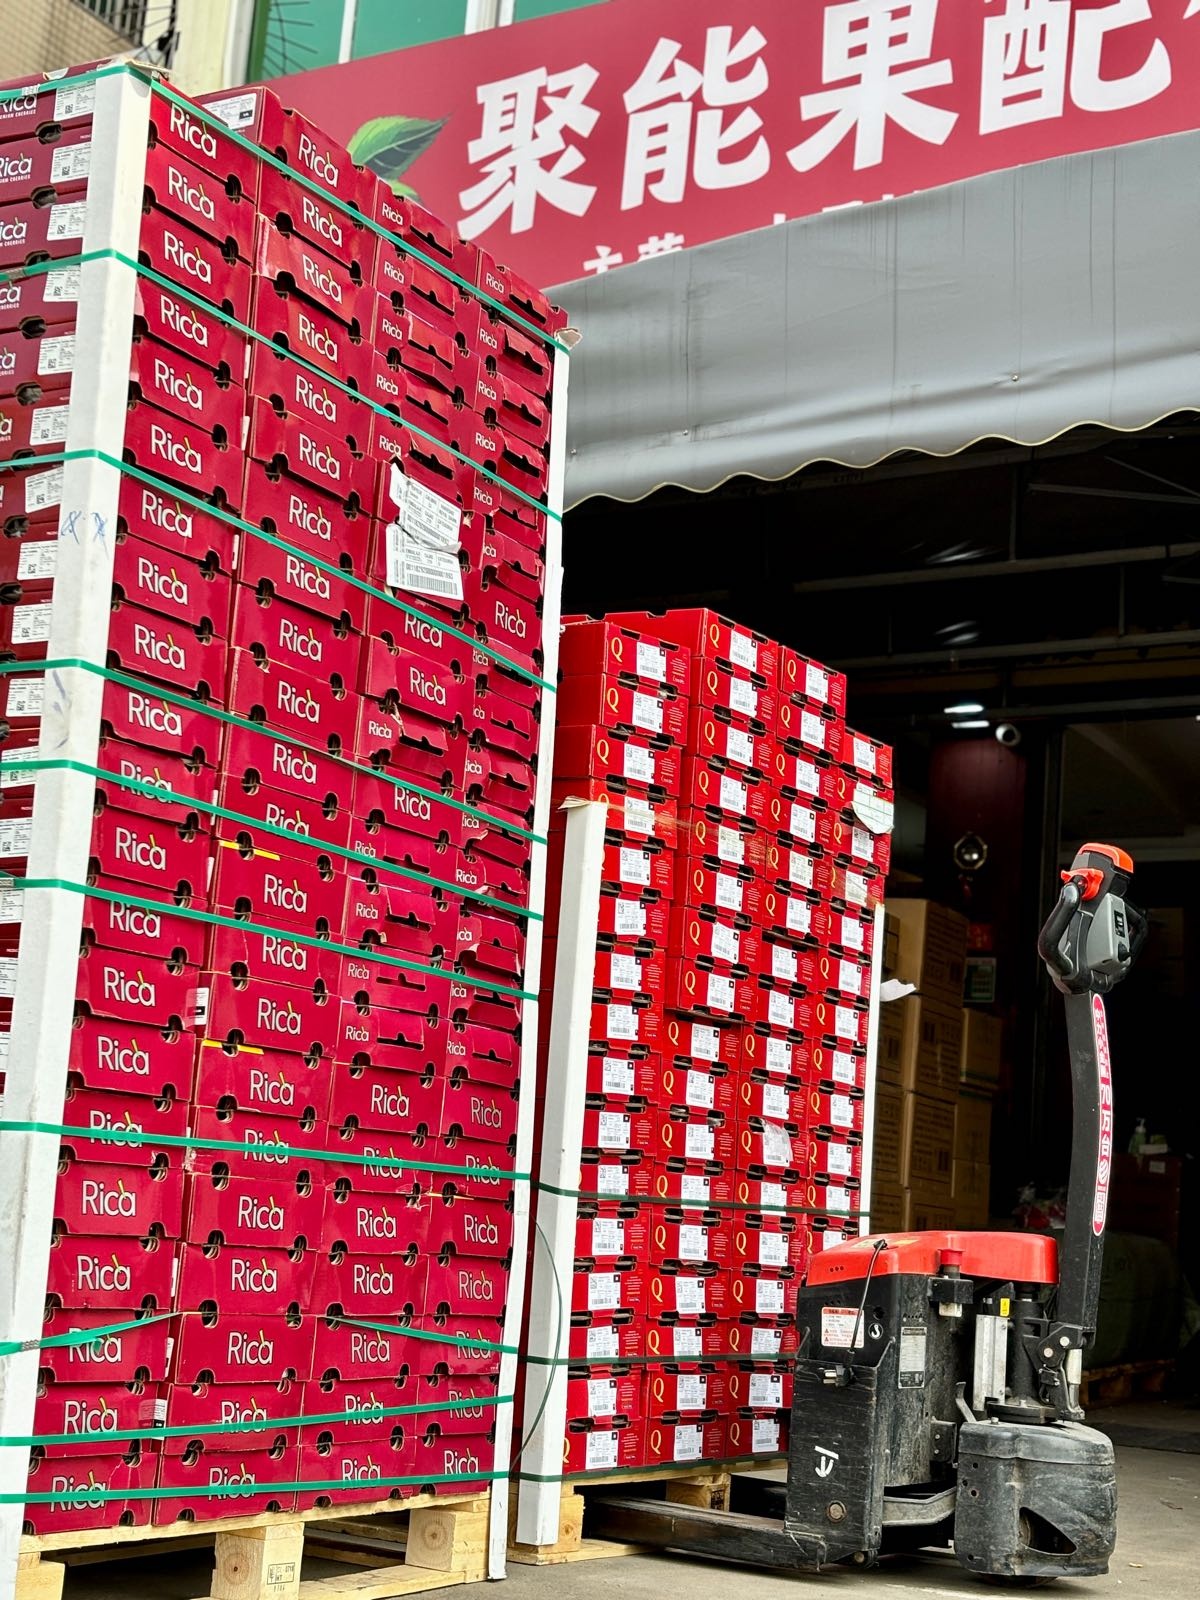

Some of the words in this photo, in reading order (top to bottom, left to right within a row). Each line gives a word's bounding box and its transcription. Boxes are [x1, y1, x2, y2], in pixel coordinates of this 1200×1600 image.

[170, 103, 216, 159] Rica
[456, 0, 1200, 239] 聚能果配
[299, 133, 338, 187] Rica
[169, 166, 214, 221] Rica
[303, 197, 342, 247] Rica
[381, 202, 404, 226] Rica
[0, 217, 27, 240] ica
[165, 231, 211, 284] Rica
[303, 254, 342, 305] Rica
[384, 261, 405, 284] Rica
[485, 272, 504, 293] Rica
[161, 295, 207, 347] Rica
[381, 319, 403, 341] Rica
[299, 314, 337, 362] Rica
[479, 328, 497, 349] Rica
[155, 359, 202, 410] Rica
[377, 374, 399, 396] Rica
[478, 382, 497, 400] Rica
[296, 375, 336, 422] Rica
[152, 425, 201, 473] Rica
[378, 434, 401, 455] Rica
[476, 432, 495, 451] Rica
[300, 433, 339, 480] Rica
[474, 487, 493, 505] Rica
[142, 490, 192, 538] Rica
[289, 495, 331, 540] Rica
[483, 545, 497, 558] ica
[139, 557, 187, 605] Rica
[287, 555, 329, 599] Rica
[405, 613, 443, 647] Rica
[496, 601, 526, 638] Rica
[135, 624, 185, 669] Rica
[280, 619, 321, 661] Rica
[709, 623, 720, 648] Q
[611, 637, 622, 663] Q
[707, 670, 718, 695] Q
[787, 659, 797, 682] Q
[410, 667, 445, 705] Rica
[278, 681, 319, 723] Rica
[606, 687, 619, 713] Q
[129, 692, 182, 735] Rica
[473, 708, 485, 719] ica
[781, 705, 791, 729] Q
[369, 721, 391, 739] Rica
[704, 721, 716, 746] Q
[273, 743, 316, 784] Rica
[596, 739, 609, 765] Q
[775, 753, 786, 776] Q
[121, 761, 171, 803] Rica
[698, 770, 709, 795] Q
[837, 777, 846, 799] Q
[395, 786, 431, 821] Rica
[770, 798, 781, 822] Q
[266, 804, 309, 837] Rica
[695, 821, 706, 845] Q
[833, 821, 843, 845] Q
[116, 828, 165, 870] Rica
[354, 840, 376, 858] Rica
[769, 846, 779, 870] Q
[456, 869, 477, 885] Rica
[693, 869, 705, 894] Q
[264, 874, 307, 912] Rica
[765, 893, 776, 917] Q
[110, 903, 160, 938] Rica
[356, 903, 378, 919] Rica
[457, 928, 473, 942] ica
[689, 921, 700, 945] Q
[263, 936, 306, 970] Rica
[347, 962, 369, 979] Rica
[820, 957, 830, 980] Q
[104, 967, 155, 1006] Rica
[685, 970, 696, 995] Q
[258, 998, 301, 1034] Rica
[816, 1003, 826, 1026] Q
[345, 1026, 369, 1041] Rica
[668, 1021, 679, 1046] Q
[745, 1034, 755, 1058] Q
[98, 1036, 149, 1074] Rica
[447, 1039, 466, 1056] Rica
[813, 1048, 823, 1071] Q
[250, 1070, 294, 1105] Rica
[663, 1070, 674, 1095] Q
[741, 1082, 752, 1106] Q
[372, 1085, 409, 1116] Rica
[471, 1097, 501, 1127] Rica
[810, 1092, 820, 1115] Q
[661, 1123, 673, 1148] Q
[741, 1130, 752, 1154] Q
[808, 1142, 817, 1164] Q
[83, 1180, 135, 1216] Rica
[656, 1175, 668, 1199] Q
[738, 1182, 749, 1204] Q
[807, 1185, 816, 1208] Q
[238, 1196, 283, 1230] Rica
[358, 1207, 396, 1237] Rica
[465, 1215, 497, 1244] Rica
[655, 1225, 666, 1250] Q
[735, 1231, 747, 1255] Q
[77, 1255, 130, 1291] Rica
[232, 1259, 276, 1292] Rica
[354, 1263, 392, 1294] Rica
[459, 1271, 492, 1301] Rica
[651, 1277, 663, 1303] Q
[732, 1279, 743, 1303] Q
[69, 1327, 121, 1362] Rica
[228, 1330, 273, 1364] Rica
[351, 1331, 389, 1362] Rica
[648, 1329, 660, 1355] Q
[729, 1327, 739, 1351] Q
[653, 1377, 664, 1403] Q
[729, 1375, 739, 1399] Q
[65, 1398, 118, 1434] Rica
[220, 1398, 267, 1434] Rica
[650, 1429, 662, 1455] Q
[729, 1422, 740, 1446] Q
[341, 1456, 381, 1490] Rica
[445, 1447, 478, 1474] Rica
